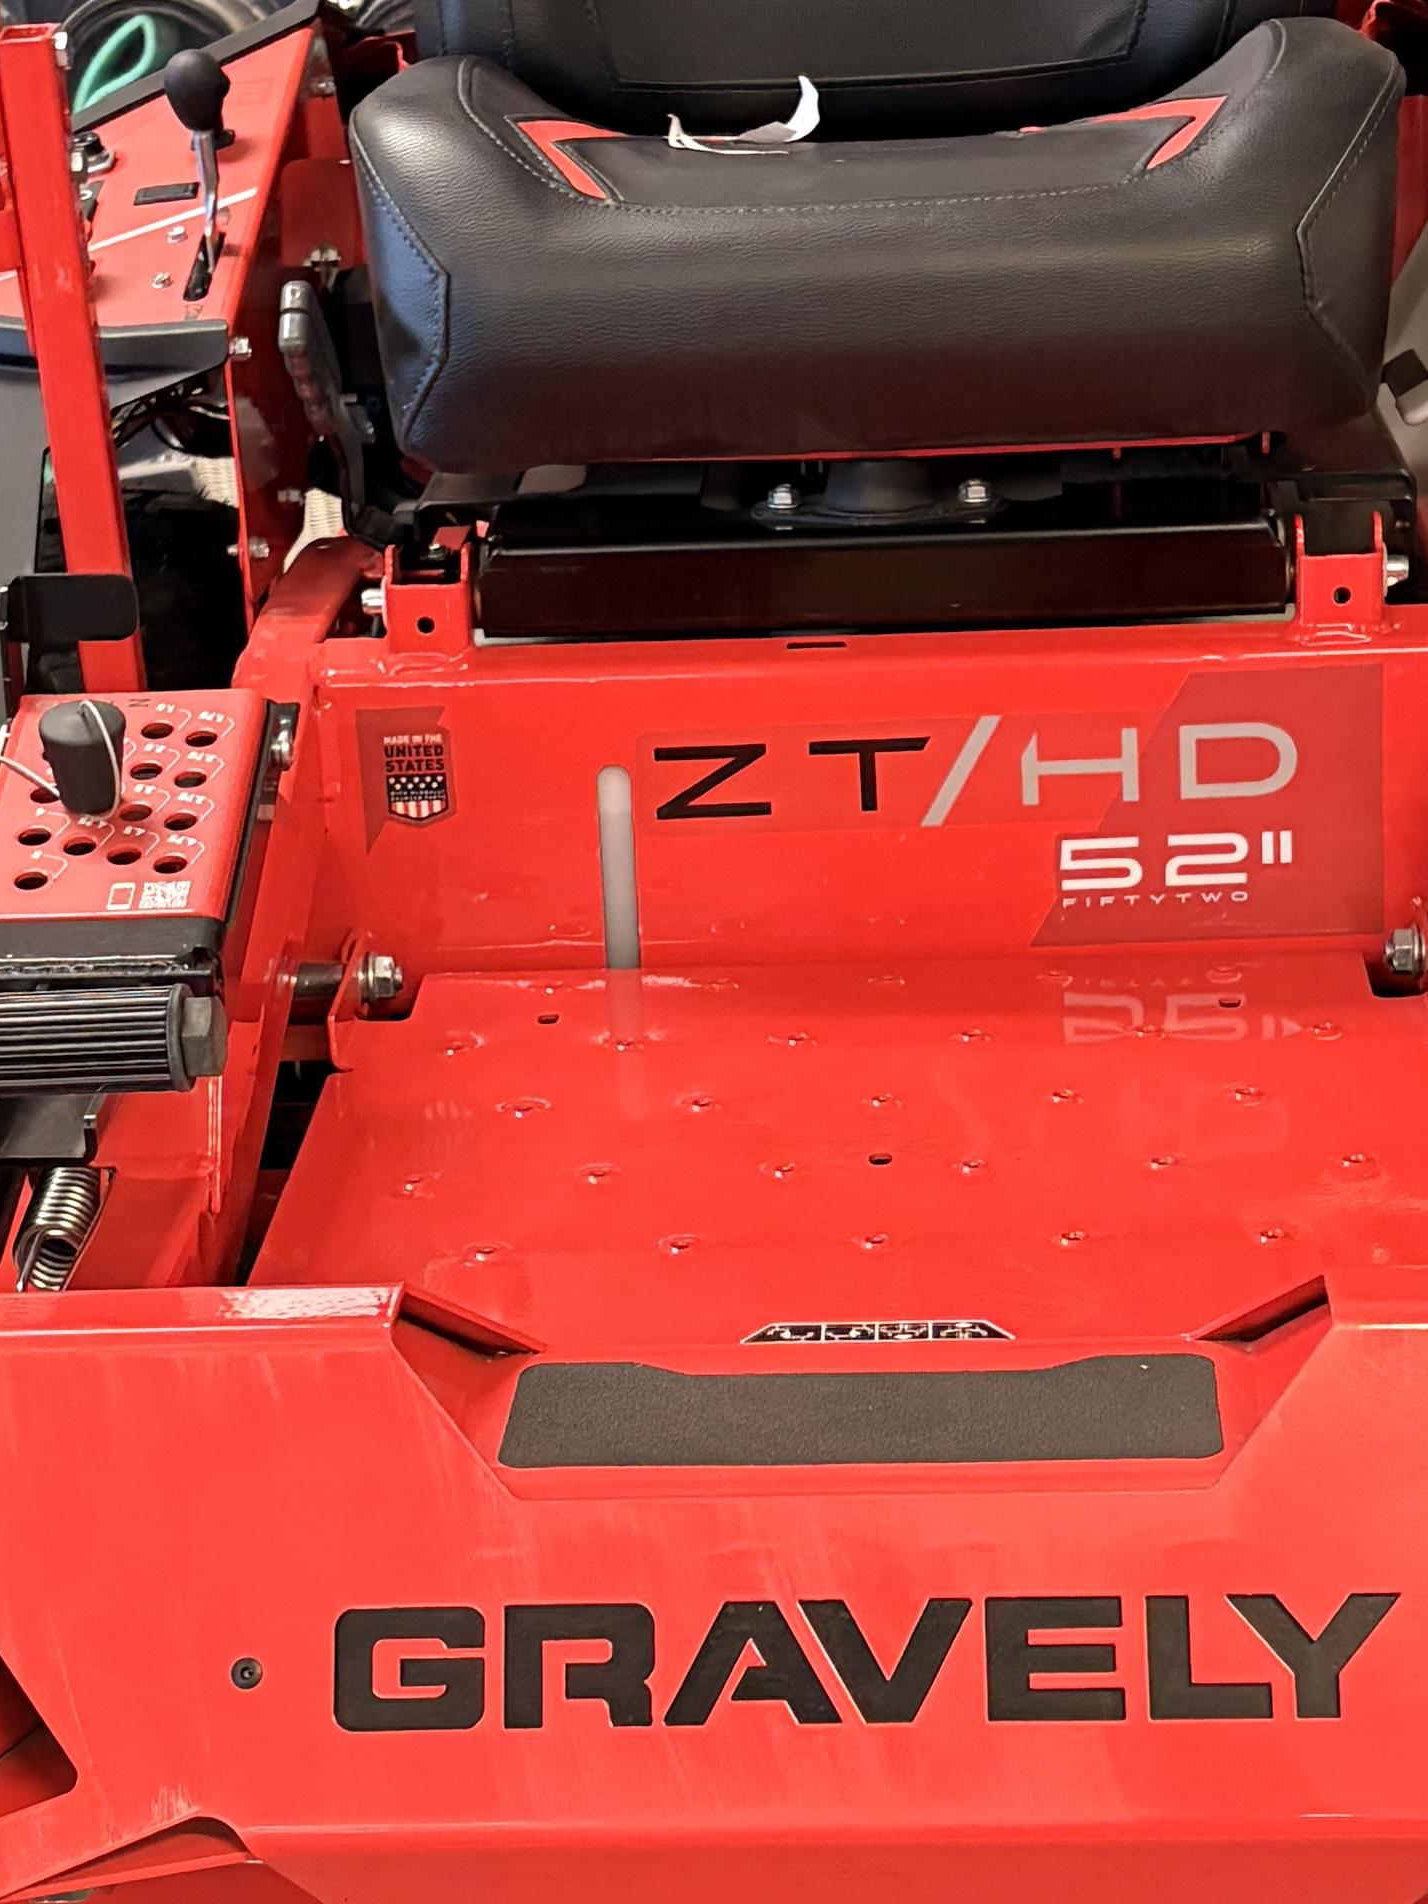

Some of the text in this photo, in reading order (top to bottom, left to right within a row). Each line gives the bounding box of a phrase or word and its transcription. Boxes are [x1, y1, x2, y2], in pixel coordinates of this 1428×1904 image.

[384, 745, 443, 758] UNITED
[386, 758, 444, 772] STATES
[1061, 890, 1251, 909] FIFTYTWO
[333, 1592, 1403, 1733] GRAVELY
